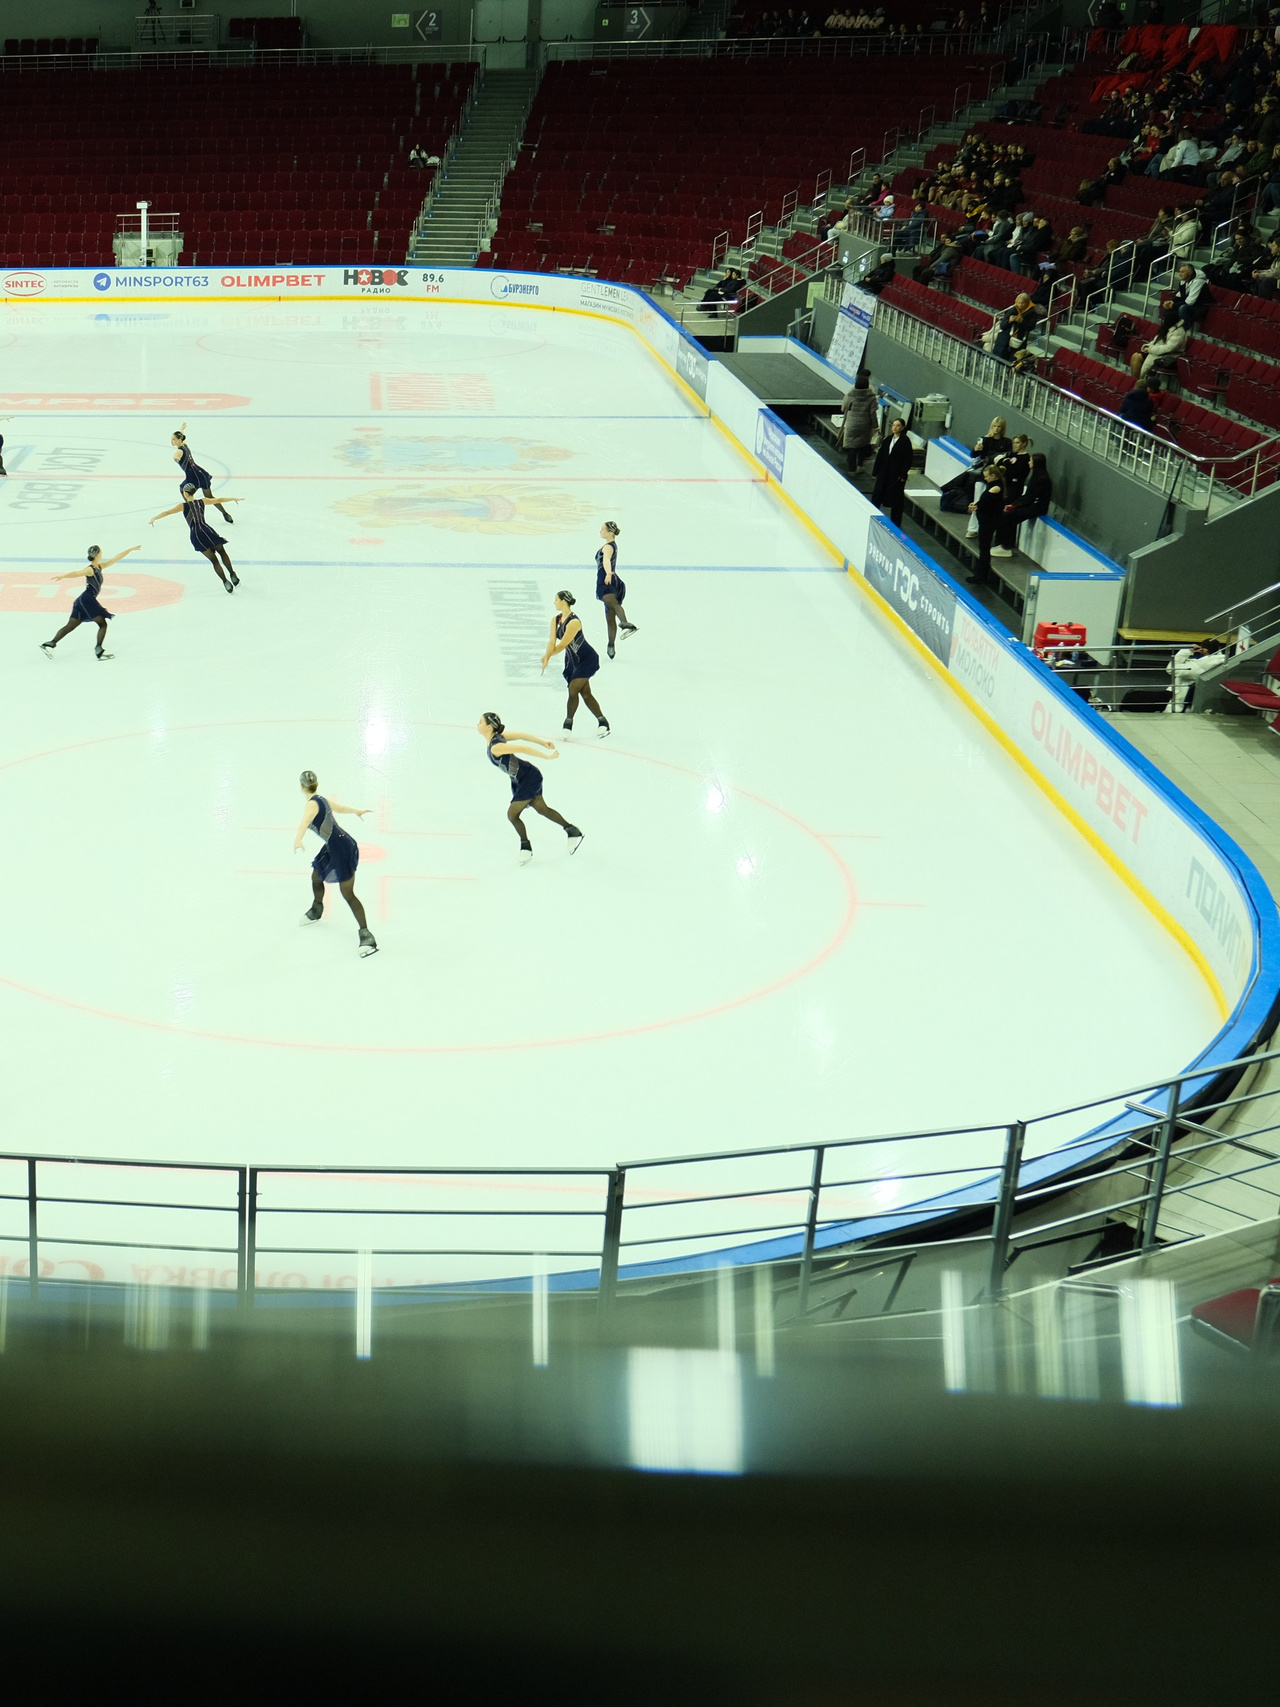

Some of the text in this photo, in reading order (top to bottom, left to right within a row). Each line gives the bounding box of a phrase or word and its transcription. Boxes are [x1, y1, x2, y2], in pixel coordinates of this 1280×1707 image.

[428, 12, 437, 26] 2
[629, 10, 639, 24] 3
[4, 280, 44, 288] SINTEC
[115, 276, 209, 287] MINSPORT63
[220, 274, 325, 287] OLIMPBET
[422, 273, 444, 283] 89.6
[426, 285, 439, 293] FM
[508, 283, 539, 295] БУРЭНЕРГО
[580, 282, 619, 299] GENTLEMEN
[868, 542, 893, 576] ЭНЕРГИЯ
[894, 558, 919, 612] ГЭС
[920, 595, 950, 635] СТРОИТЬ
[955, 643, 995, 698] МОЛОКО
[1031, 700, 1148, 845] OLIMPBET
